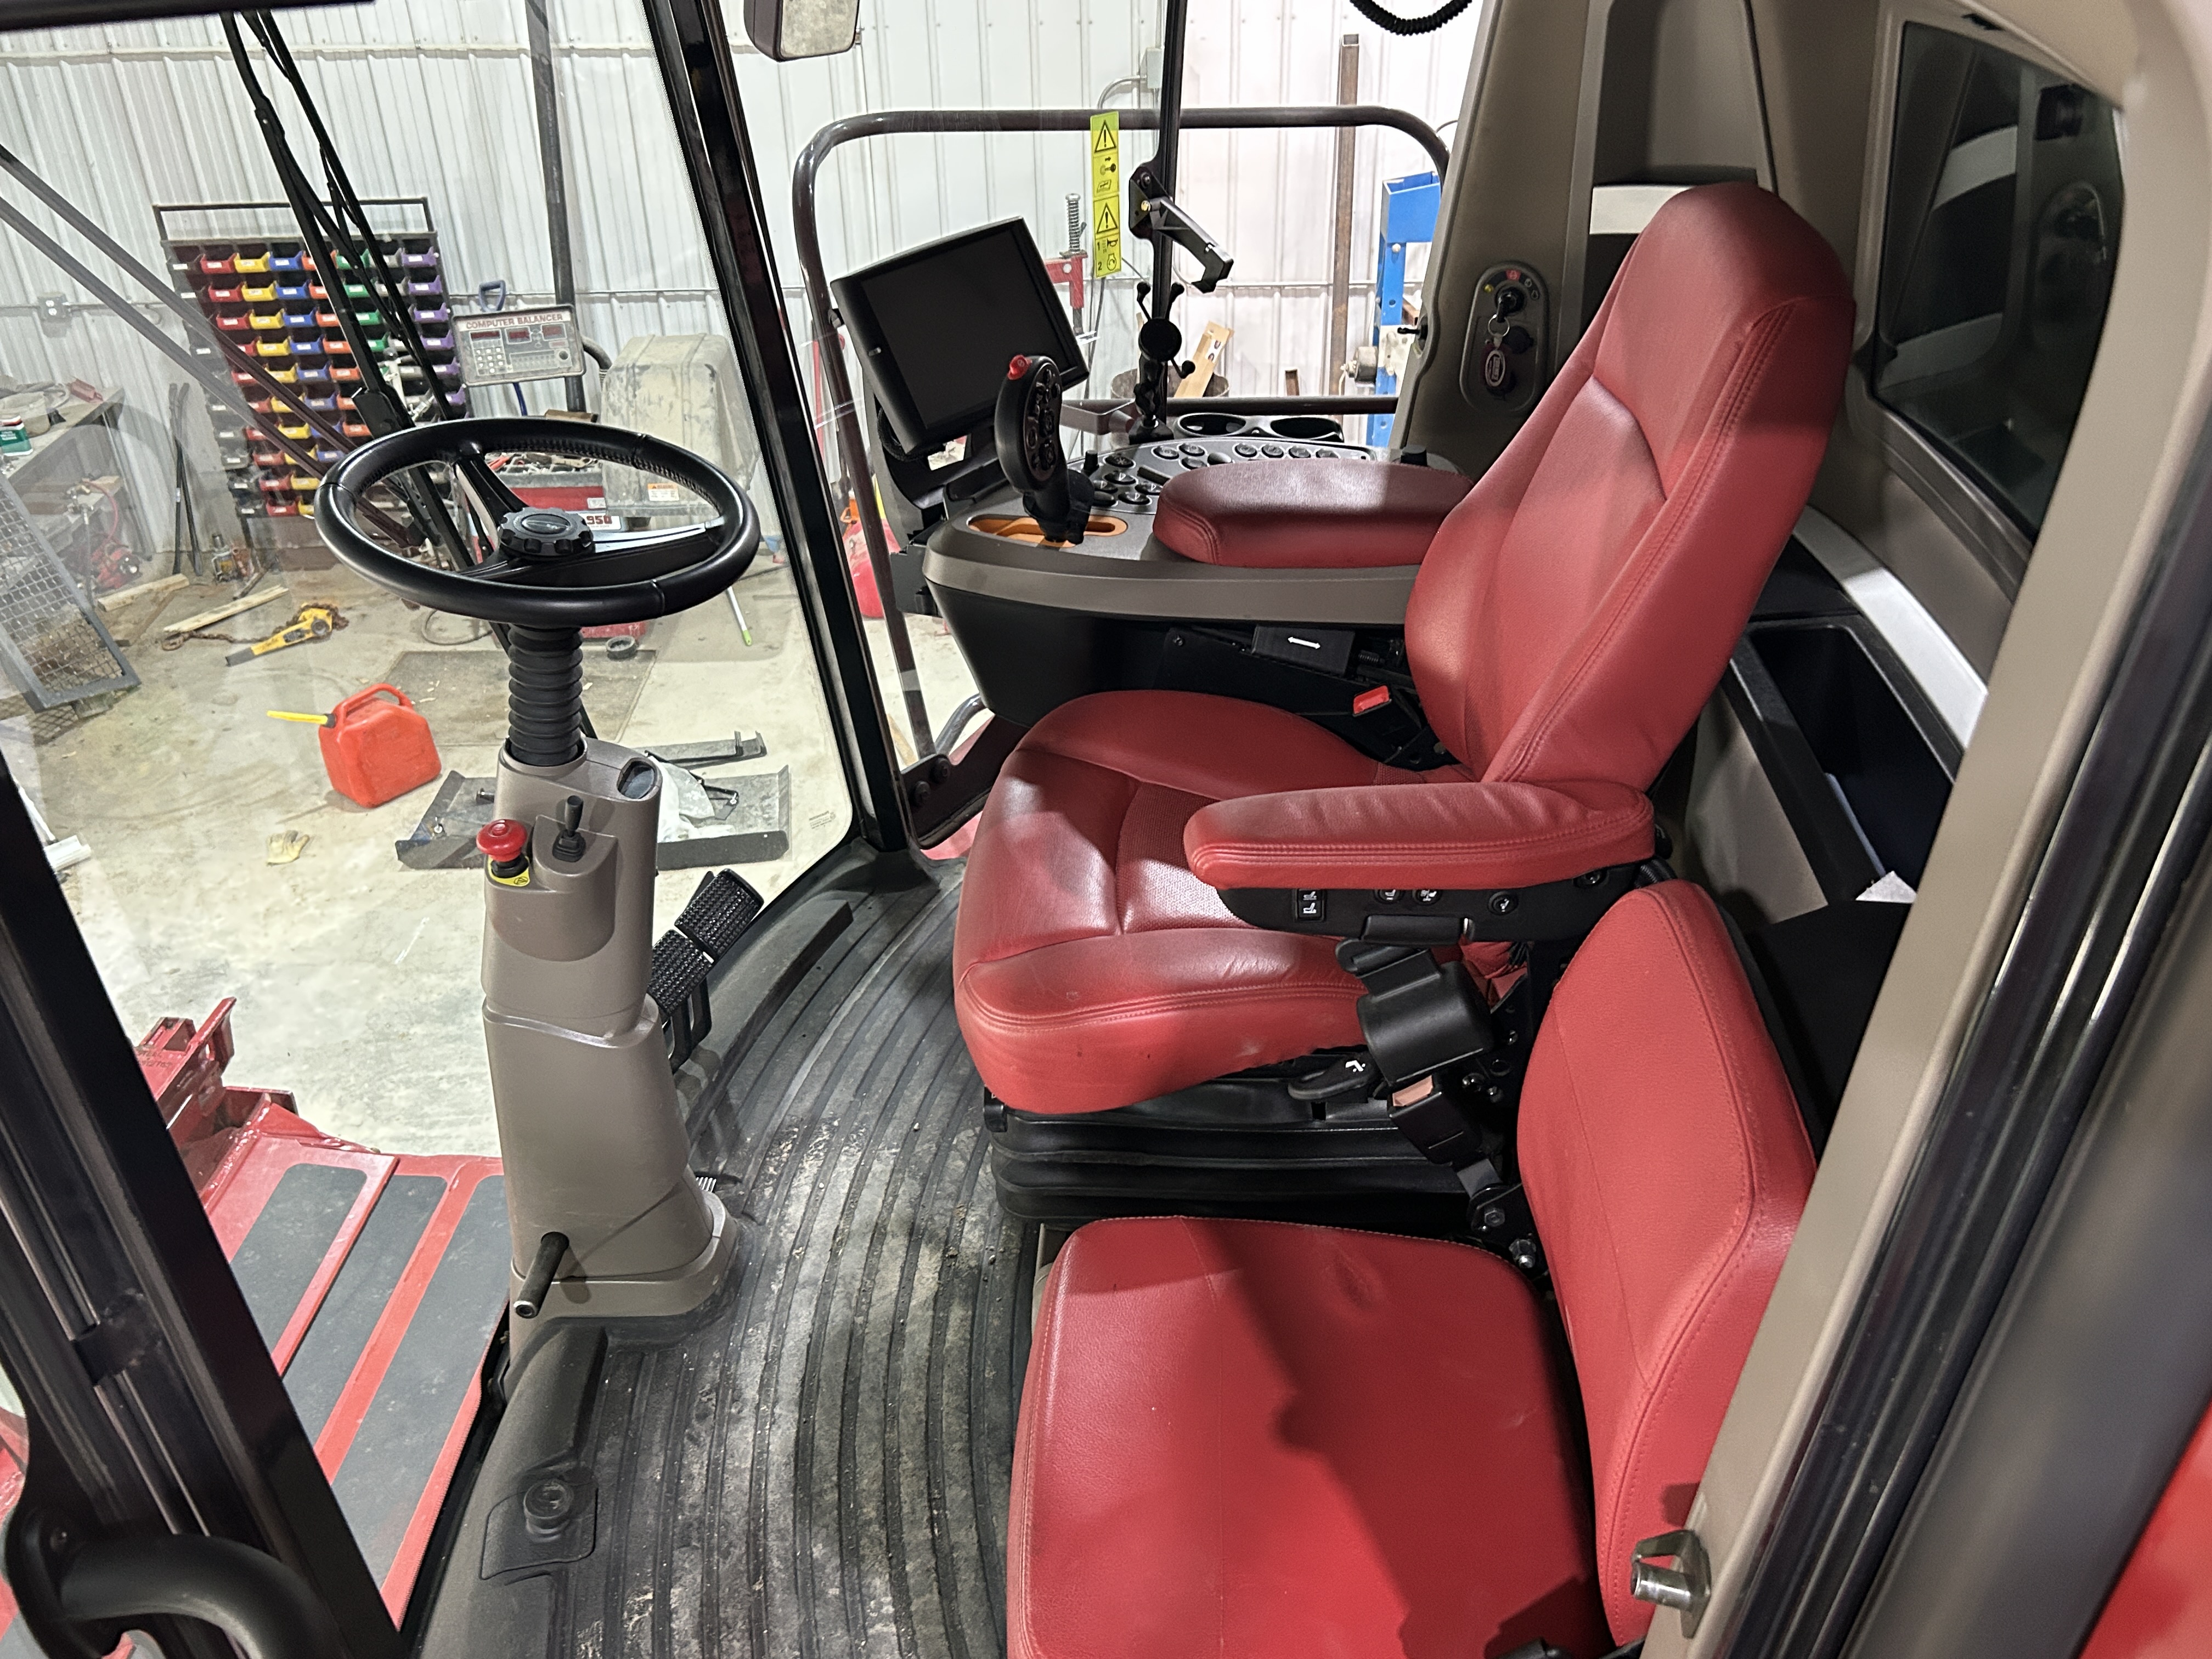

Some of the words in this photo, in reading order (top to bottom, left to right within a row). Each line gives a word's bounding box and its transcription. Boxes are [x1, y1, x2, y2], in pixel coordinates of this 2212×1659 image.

[1098, 261, 1102, 270] 2
[466, 318, 515, 329] COMPUTER
[517, 313, 563, 324] BALANCER
[586, 515, 612, 524] 950
